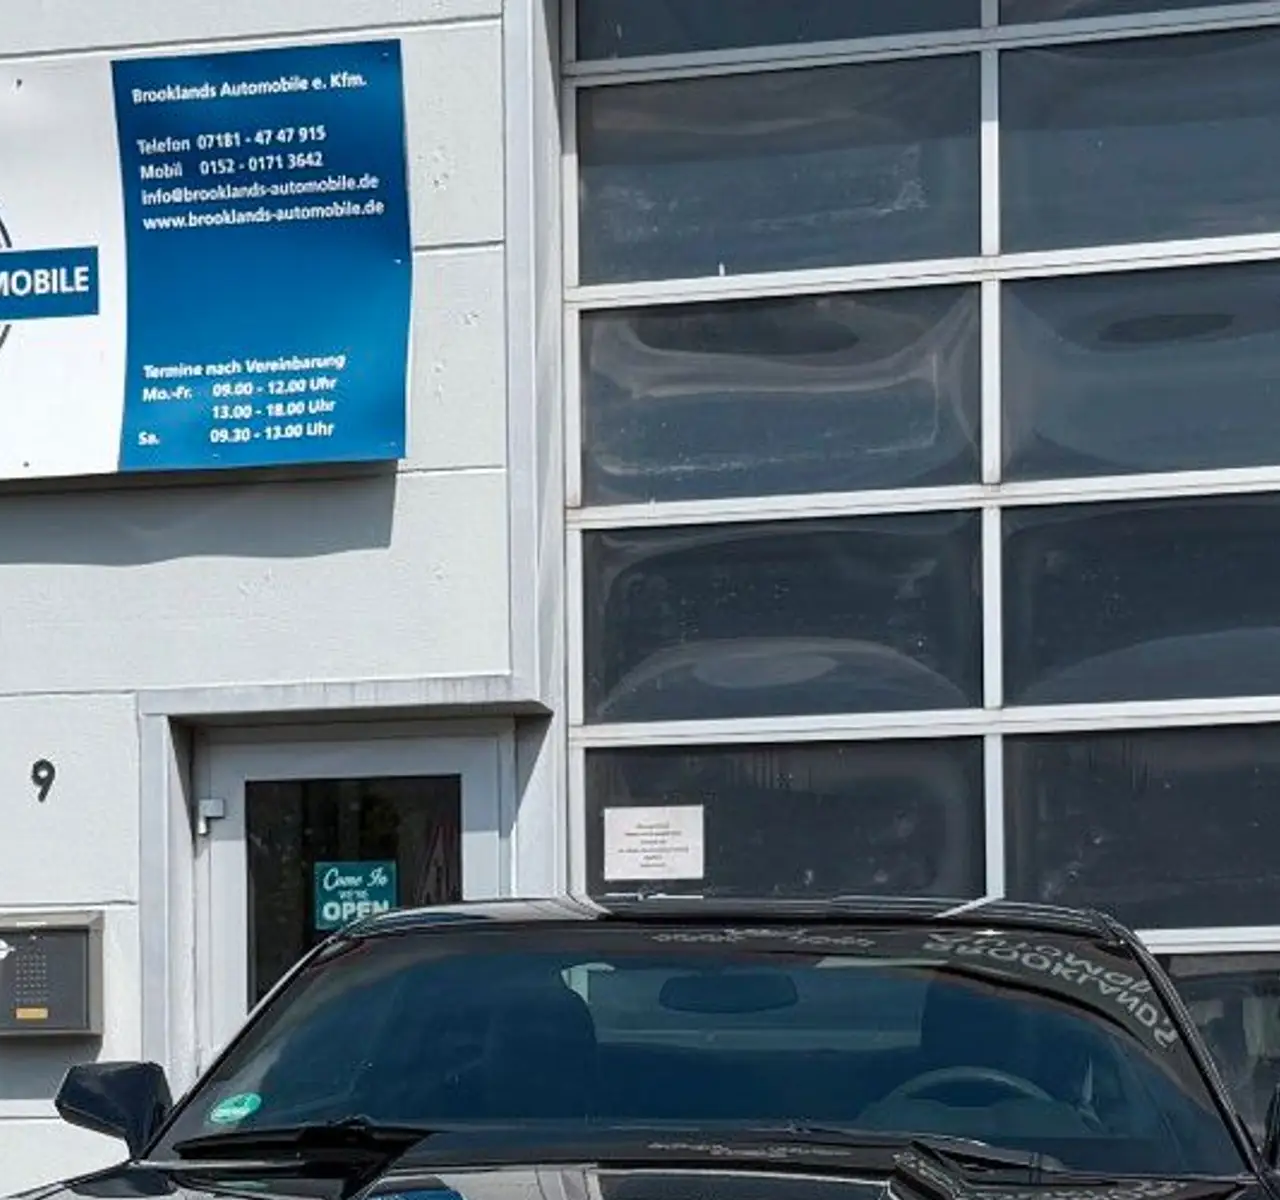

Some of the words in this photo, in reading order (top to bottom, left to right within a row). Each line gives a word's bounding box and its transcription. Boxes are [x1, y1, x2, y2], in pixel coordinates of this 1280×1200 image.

[132, 82, 216, 104] Brooklands
[221, 75, 308, 97] Automobile
[312, 78, 327, 90] e.
[330, 72, 367, 88] Kfm.
[137, 137, 191, 155] Telefon
[197, 132, 241, 150] 07181
[254, 129, 272, 146] 47
[276, 127, 294, 144] 47
[298, 124, 327, 142] 915
[140, 162, 183, 180] Mobil
[200, 158, 235, 175] 0152
[248, 155, 283, 172] 0171
[287, 151, 323, 169] 3642
[141, 174, 380, 205] info@brooklands-automobile.de
[143, 199, 385, 231] www.brooklands-automobile.de
[143, 363, 203, 379] Termine
[206, 360, 241, 376] nach
[245, 353, 347, 374] Vereinbarung
[142, 386, 193, 403] Mo.-Fr.
[212, 382, 254, 398] 09.00
[267, 379, 307, 395] 12.00
[309, 375, 338, 391] Uhr
[212, 404, 253, 420] 13.00
[308, 398, 337, 414] Uhr
[138, 430, 160, 446] Sa.
[210, 427, 251, 444] 09.30
[265, 424, 303, 440] 13.00
[305, 421, 335, 437] Uhr
[31, 759, 56, 803] 9
[323, 867, 363, 891] Come
[323, 899, 389, 921] OPEN
